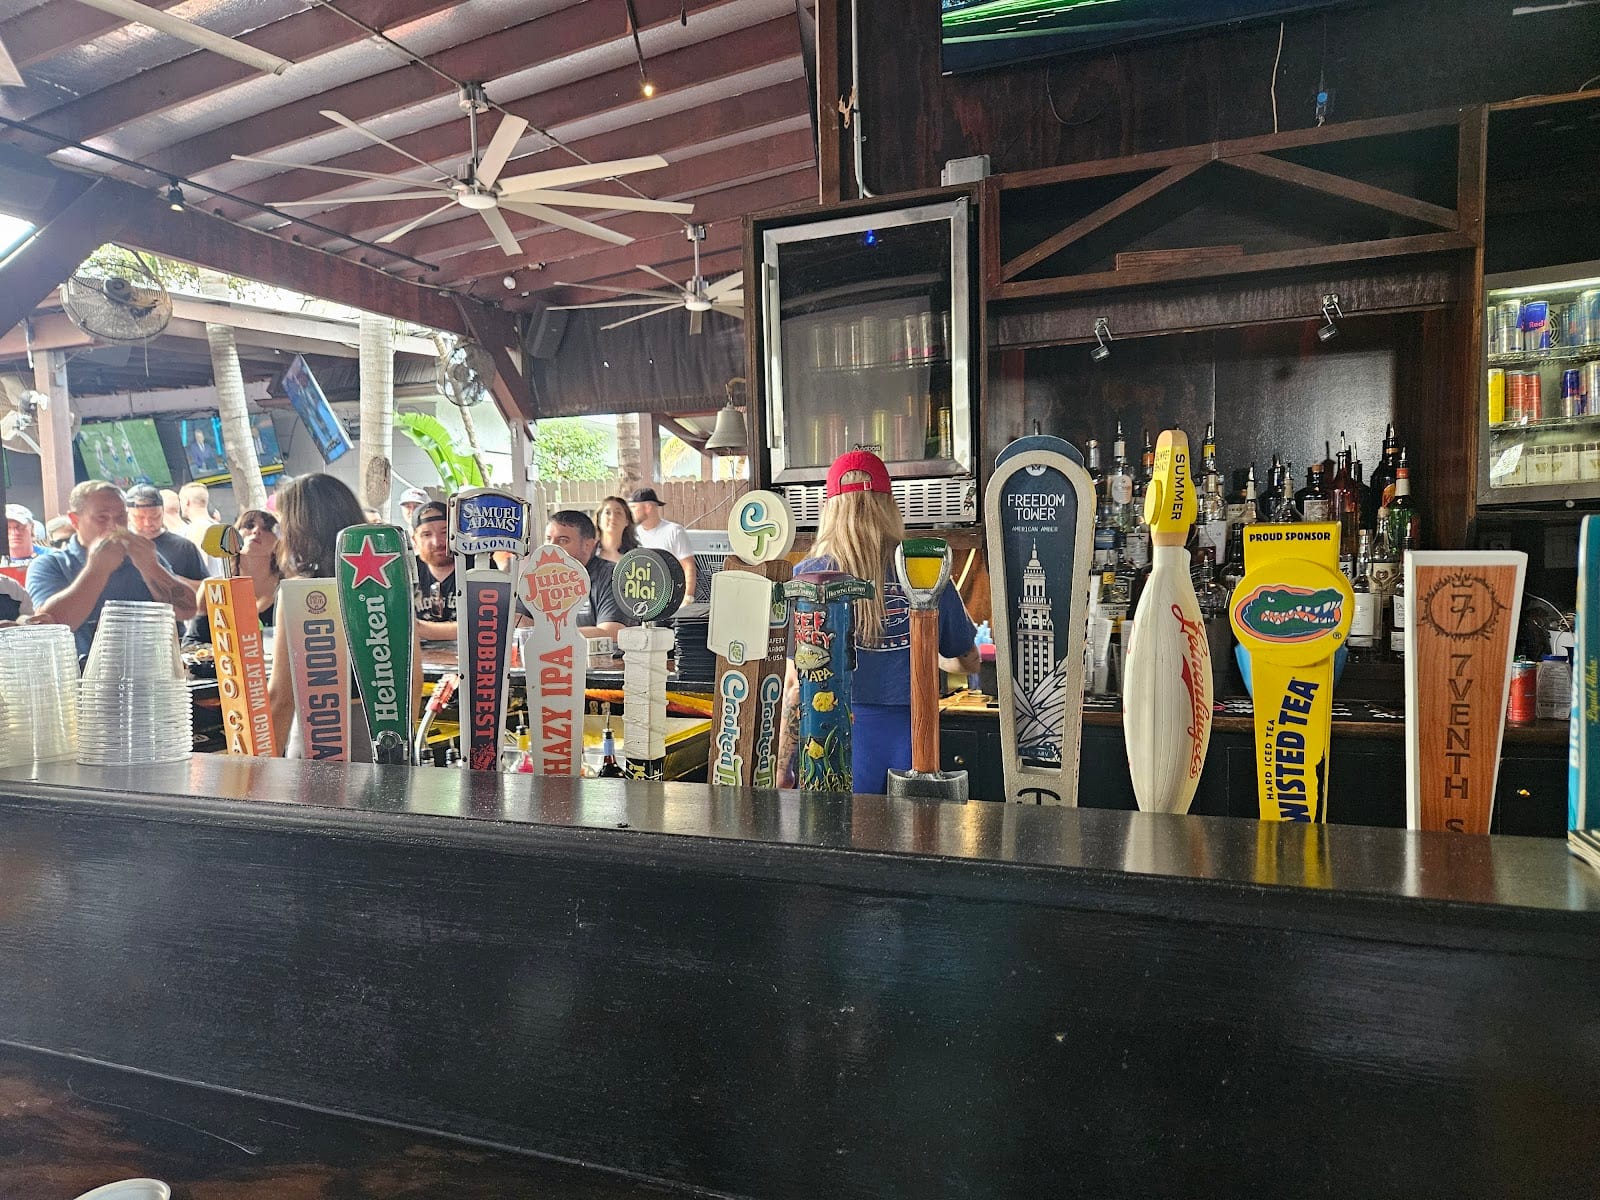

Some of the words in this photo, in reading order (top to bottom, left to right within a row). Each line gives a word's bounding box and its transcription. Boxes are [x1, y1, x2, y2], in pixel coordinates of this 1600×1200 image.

[1007, 493, 1065, 507] FREEDOM
[1171, 453, 1186, 520] SUMMER
[463, 503, 520, 520] SAMUEL
[466, 517, 516, 533] ADAMS
[1014, 507, 1056, 521] TOWER
[462, 540, 517, 551] SEASONAL
[1249, 532, 1283, 542] PROUD
[1285, 532, 1331, 541] SPONSOR
[524, 570, 580, 602] Juice
[625, 563, 651, 582] Jai
[539, 580, 588, 613] Lord
[624, 581, 657, 600] Alai
[208, 584, 240, 700] MANGO
[241, 632, 259, 659] ALE
[304, 618, 339, 688] GOON
[366, 594, 399, 722] Heineken
[474, 589, 499, 745] OCTOBERFEST
[540, 645, 573, 696] IPA
[809, 668, 834, 682] APA
[245, 663, 267, 711] WHEAT
[1278, 680, 1320, 726] TEA
[307, 693, 344, 762] SQUA
[718, 673, 745, 767] Crooked
[758, 677, 780, 769] Crooked
[1266, 719, 1275, 738] TEA
[1444, 653, 1473, 801] 7VENTH
[543, 707, 572, 776] HAZY
[1264, 743, 1272, 767] ICED
[1265, 771, 1274, 800] HARD
